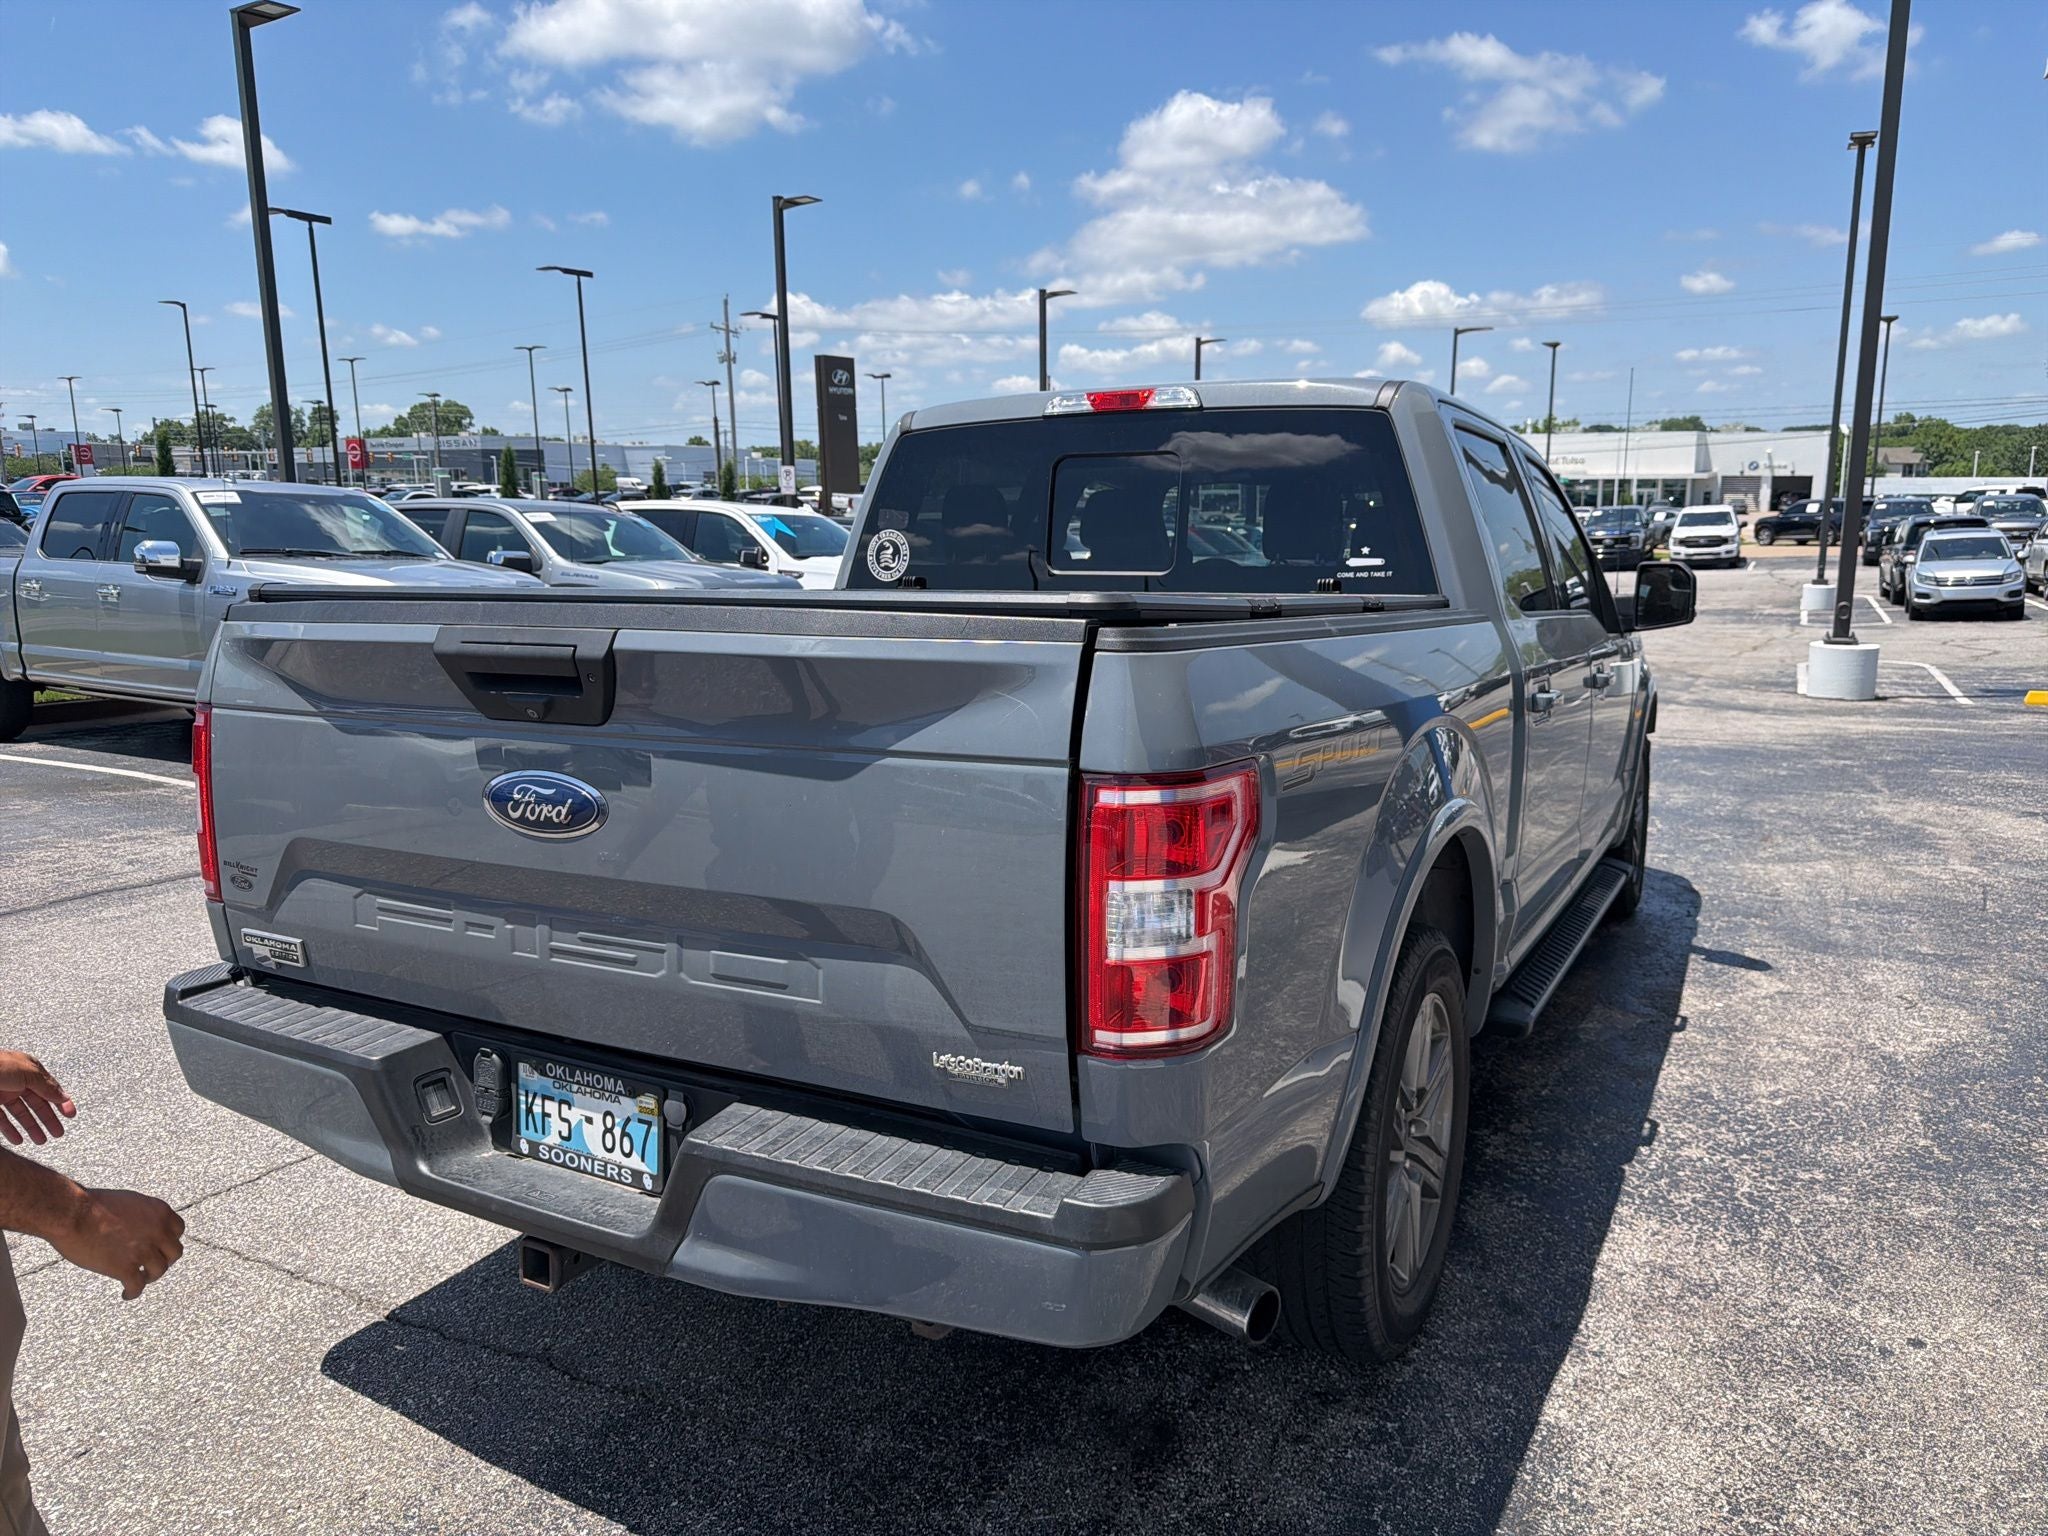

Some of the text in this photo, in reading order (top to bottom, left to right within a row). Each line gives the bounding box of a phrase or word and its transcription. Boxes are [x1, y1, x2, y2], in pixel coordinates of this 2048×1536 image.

[1281, 729, 1385, 792] SPORT
[507, 784, 574, 824] Ford
[245, 935, 297, 952] OKLAHOMA
[353, 890, 823, 1005] F-150
[546, 1063, 626, 1095] OKLAHOMA
[552, 1080, 622, 1106] OKLAHOMA
[957, 1073, 998, 1085] EDITION
[538, 1144, 633, 1184] SOONERS
